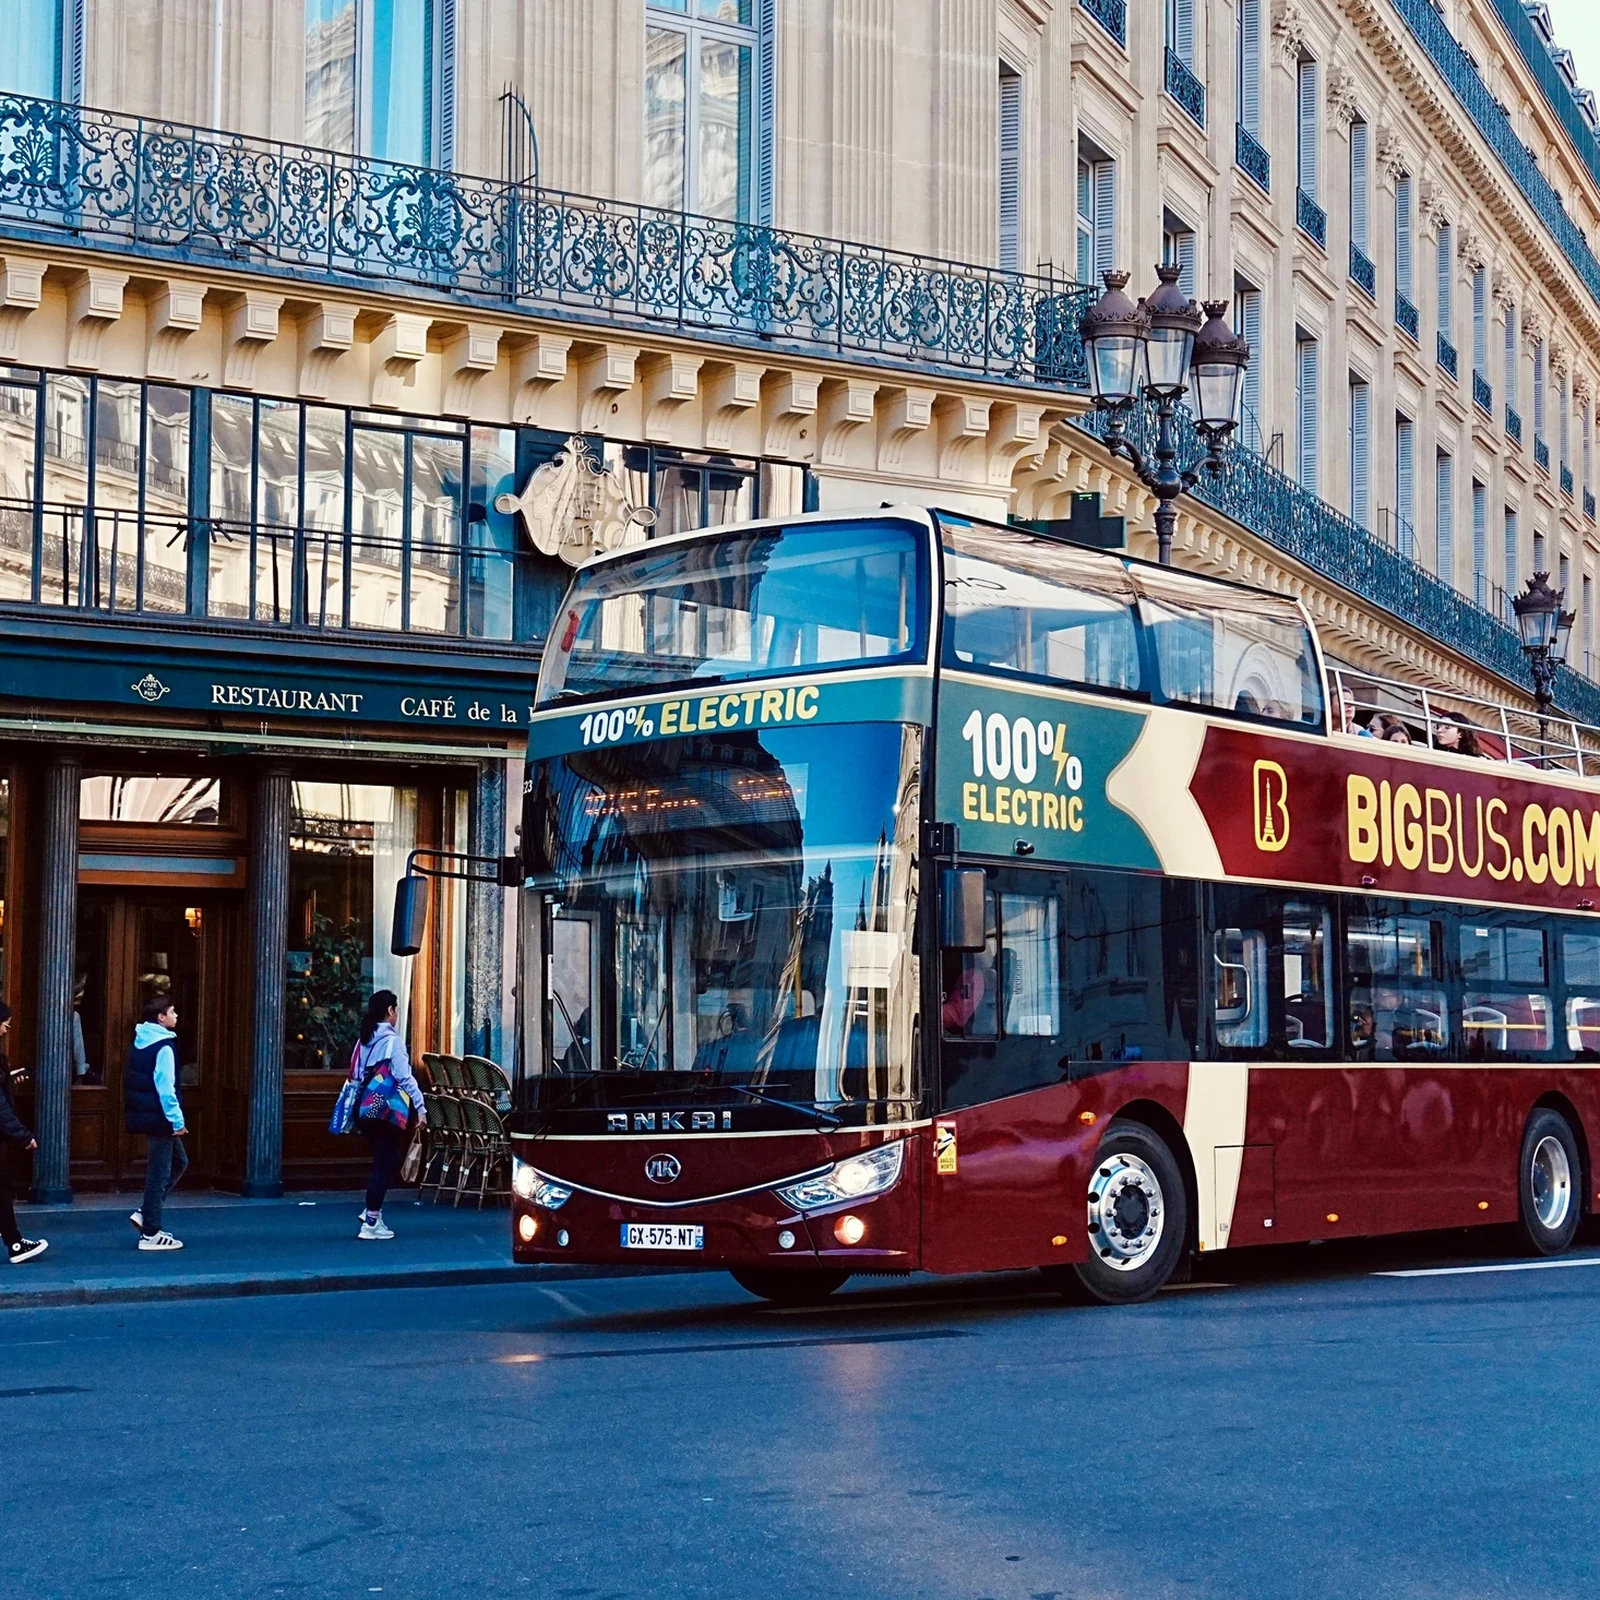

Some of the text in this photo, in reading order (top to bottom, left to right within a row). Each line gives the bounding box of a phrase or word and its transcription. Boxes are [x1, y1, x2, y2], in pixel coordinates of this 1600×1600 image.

[211, 684, 363, 712] RESTAURANT
[400, 696, 456, 718] CAFÉ
[467, 702, 491, 720] de
[501, 703, 518, 723] la
[579, 686, 820, 745] 100% ELECTRIC
[962, 709, 1083, 790] 100%
[963, 782, 1083, 832] ELECTRIC
[1347, 773, 1600, 888] BIGBUS.COM
[607, 1111, 732, 1131] ANKAI
[629, 1227, 694, 1246] GX-575-NT
